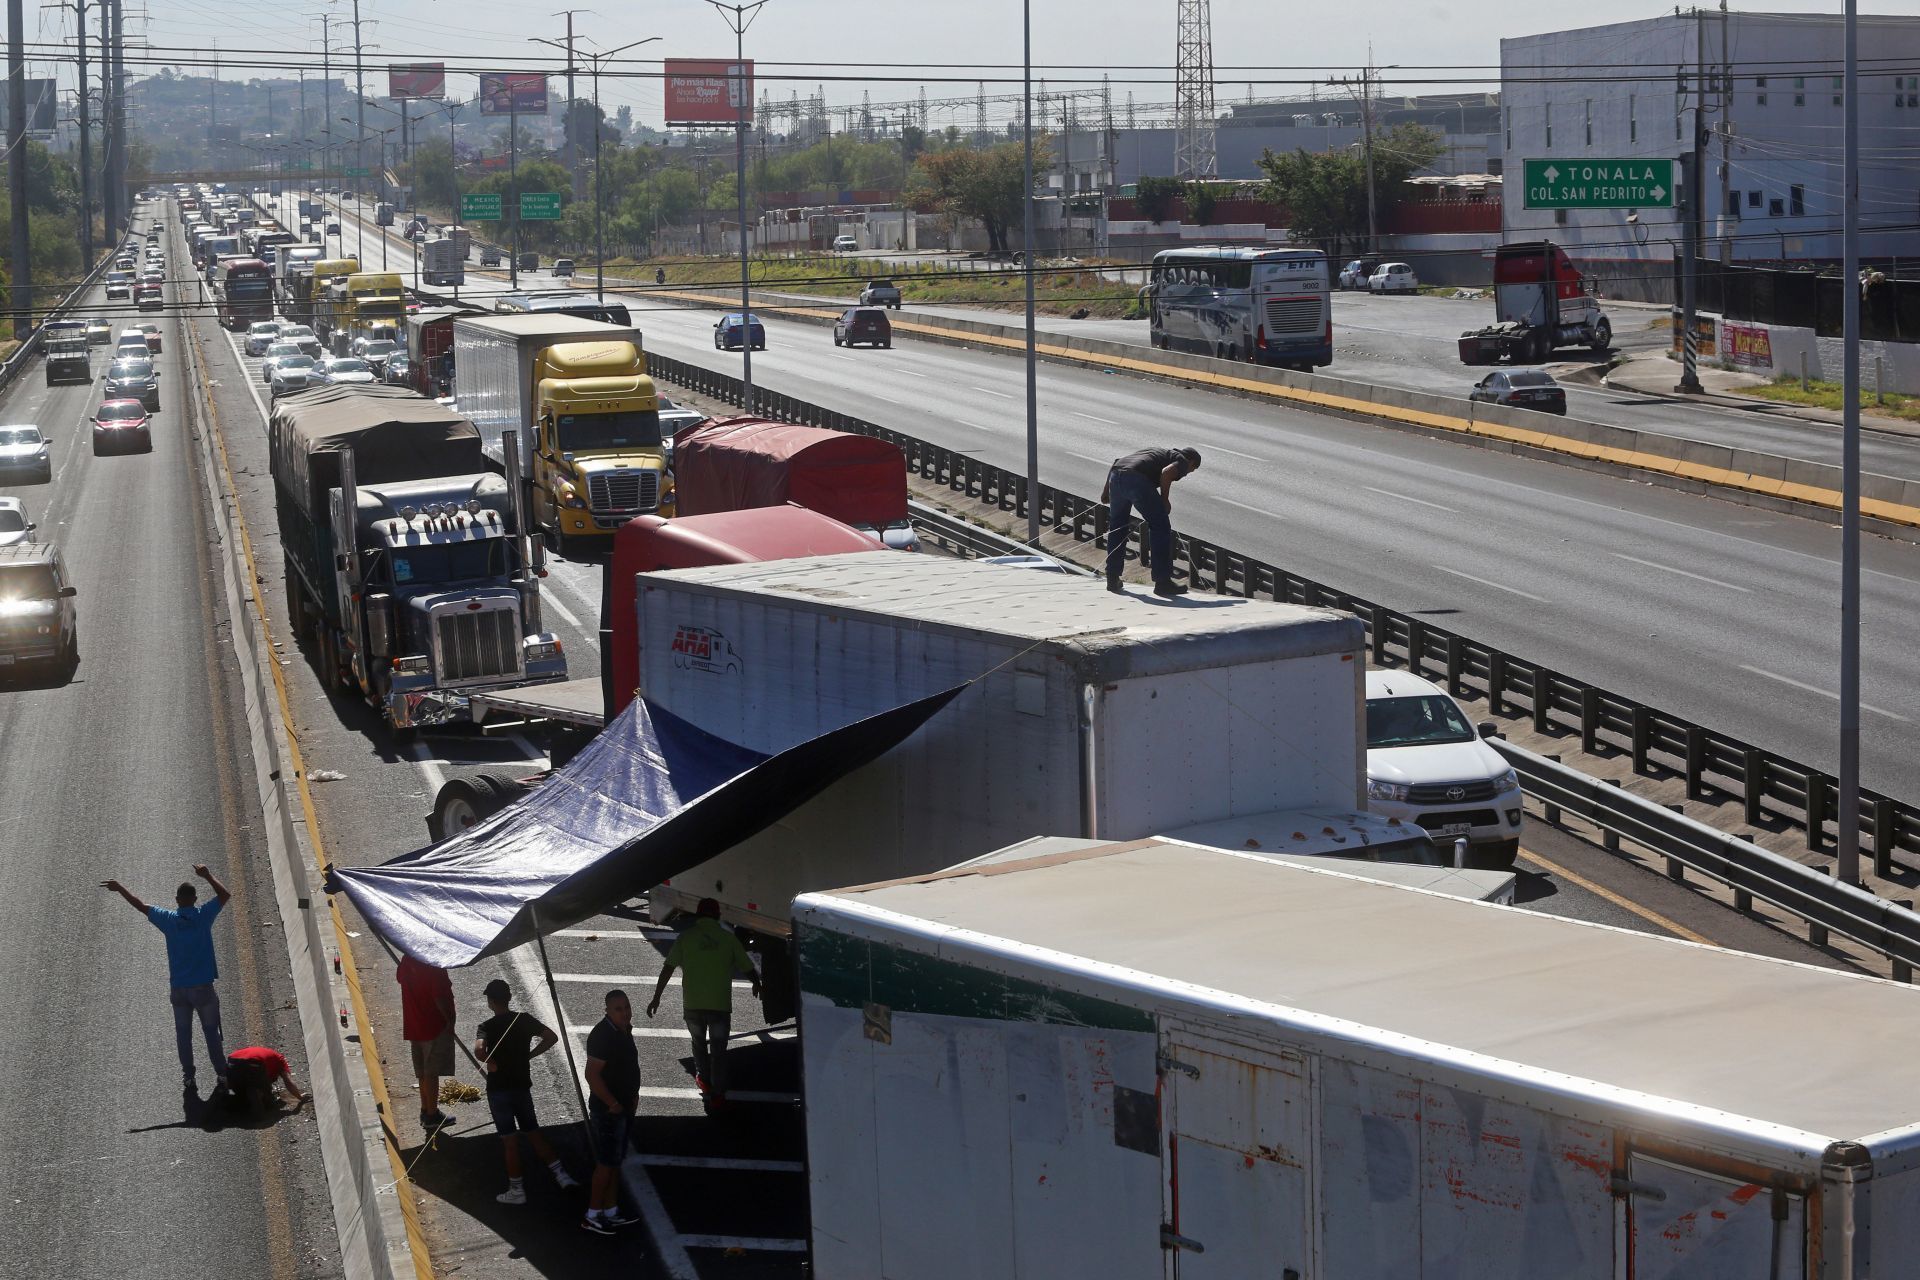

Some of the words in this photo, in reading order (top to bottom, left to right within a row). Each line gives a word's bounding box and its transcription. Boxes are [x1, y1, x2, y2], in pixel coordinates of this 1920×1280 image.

[686, 78, 704, 86] más
[677, 87, 695, 96] Ahora
[696, 86, 720, 97] Rappi
[1568, 167, 1655, 180] TONALA
[1531, 187, 1558, 200] COL.
[1562, 187, 1586, 200] SAN
[1593, 187, 1646, 200] PEDRITO
[1302, 282, 1320, 290] 9002
[672, 630, 709, 656] ARA
